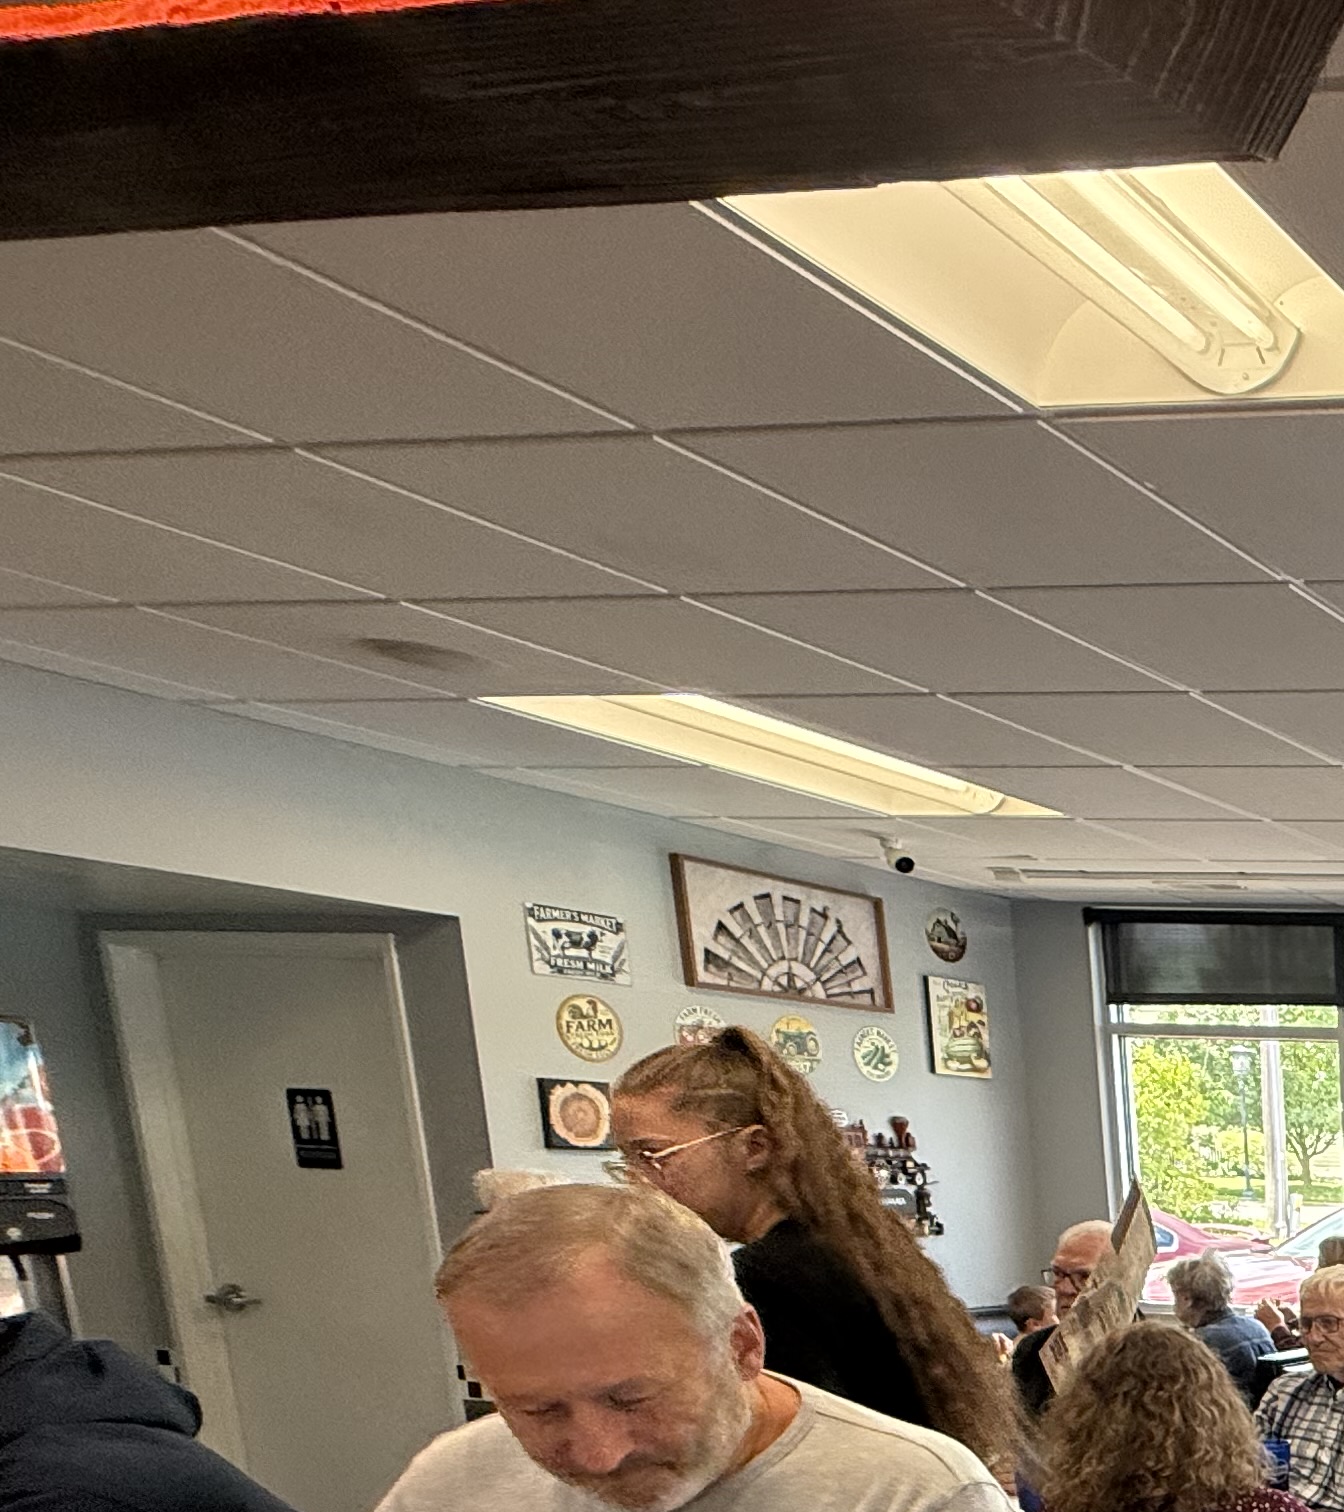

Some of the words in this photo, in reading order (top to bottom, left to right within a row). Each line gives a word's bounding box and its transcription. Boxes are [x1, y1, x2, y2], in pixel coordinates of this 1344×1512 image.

[533, 906, 579, 921] FARMER'S
[580, 914, 617, 933] MARKET
[550, 957, 584, 970] FRESH
[586, 962, 613, 974] MILK
[566, 1018, 613, 1034] FARM
